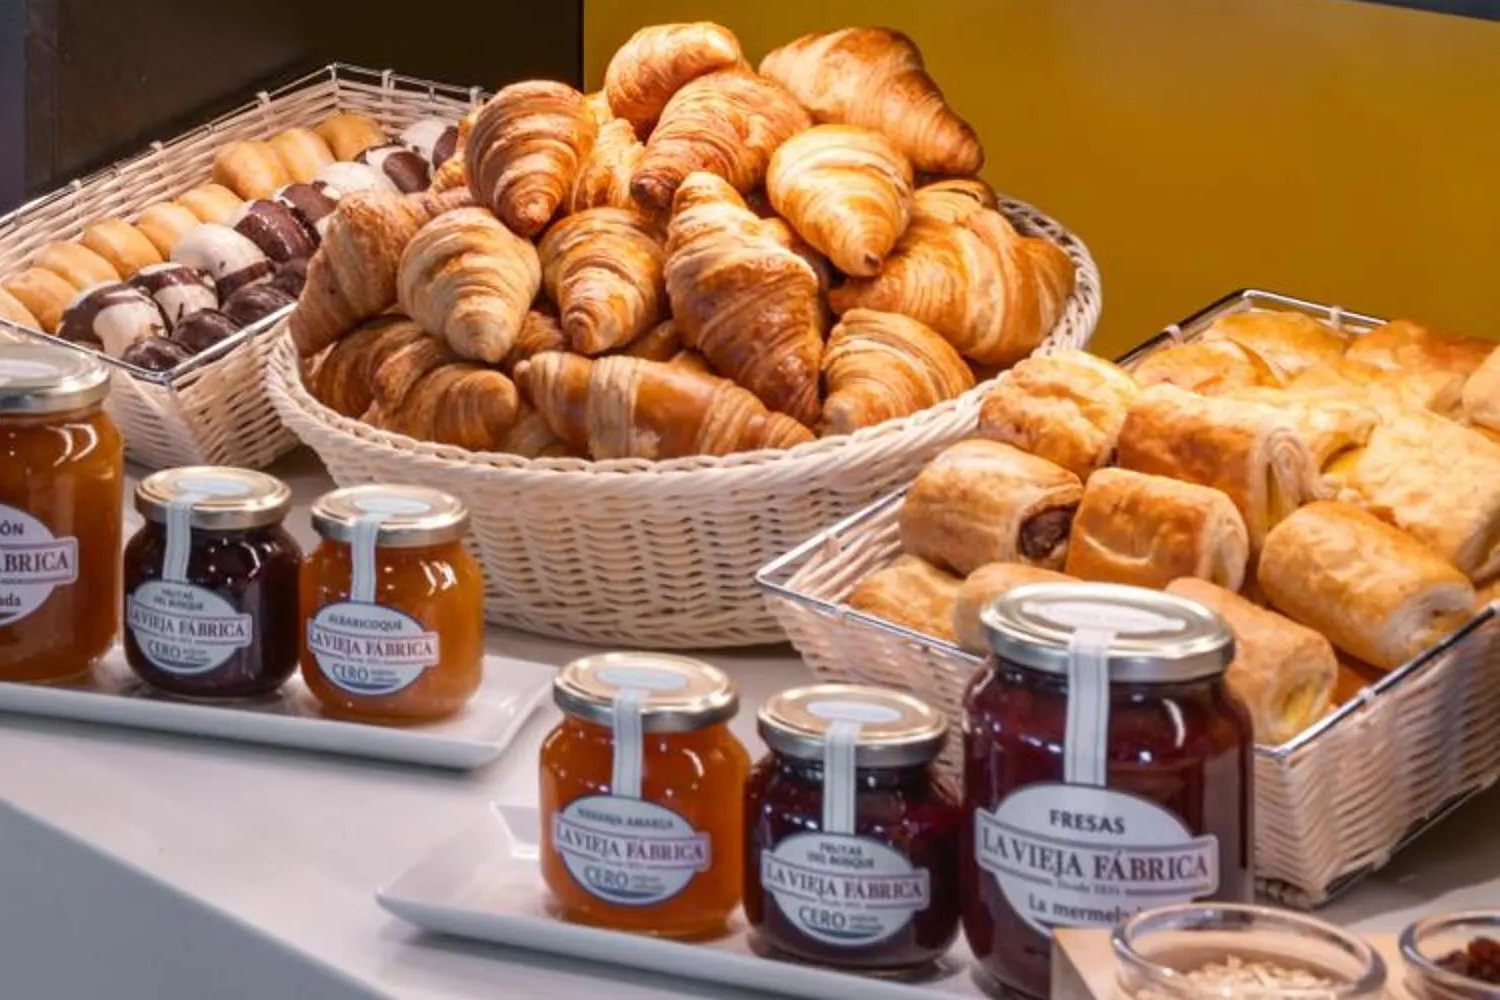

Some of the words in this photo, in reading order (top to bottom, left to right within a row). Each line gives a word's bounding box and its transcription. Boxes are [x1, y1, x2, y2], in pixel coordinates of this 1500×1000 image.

[323, 634, 360, 655] VIEJA
[366, 638, 432, 657] FÁBRICA
[332, 663, 369, 682] CERO
[1050, 808, 1125, 835] FRESAS
[574, 830, 621, 858] VIEJA
[626, 838, 705, 861] FÁBRICA
[982, 827, 1010, 860] LA
[1010, 839, 1084, 878] VIEJA
[1092, 850, 1209, 883] FÁBRICA
[788, 871, 837, 896] VIEJA
[844, 879, 923, 900] FÁBRICA
[1029, 894, 1048, 912] La
[799, 905, 846, 930] CERO
